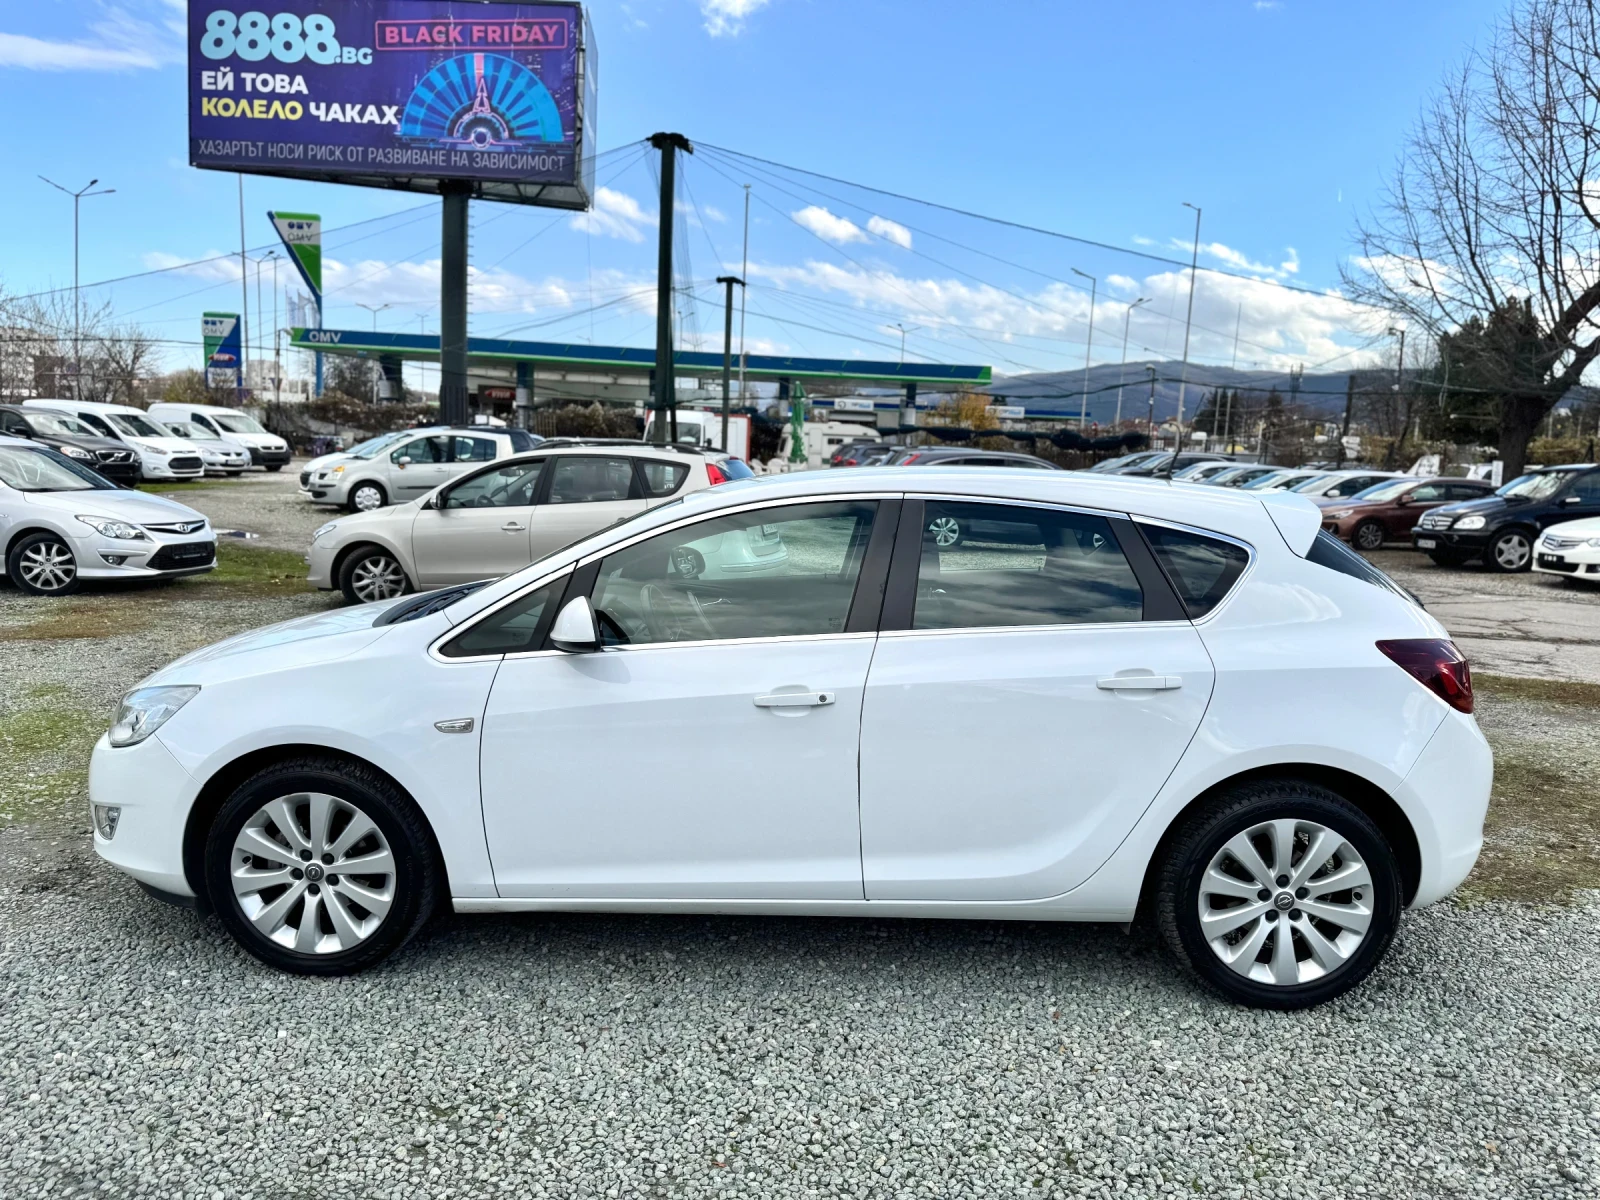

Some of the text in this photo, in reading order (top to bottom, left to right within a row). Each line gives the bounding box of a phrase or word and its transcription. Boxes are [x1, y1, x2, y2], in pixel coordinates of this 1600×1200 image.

[200, 10, 373, 65] 8888.BG
[385, 25, 559, 43] BLACK FRIDAY
[201, 66, 309, 94] ЕЙ ТОВА
[202, 97, 398, 125] КОЛЕЛО ЧАКАХ
[199, 140, 566, 172] ХАЗАРТЪТ НОСИ РИСК ОТ РАЗВИВАНЕ НА ЗАВИСИМОСТ
[287, 232, 313, 243] OMV
[203, 326, 225, 336] OMV
[308, 330, 342, 344] OMV
